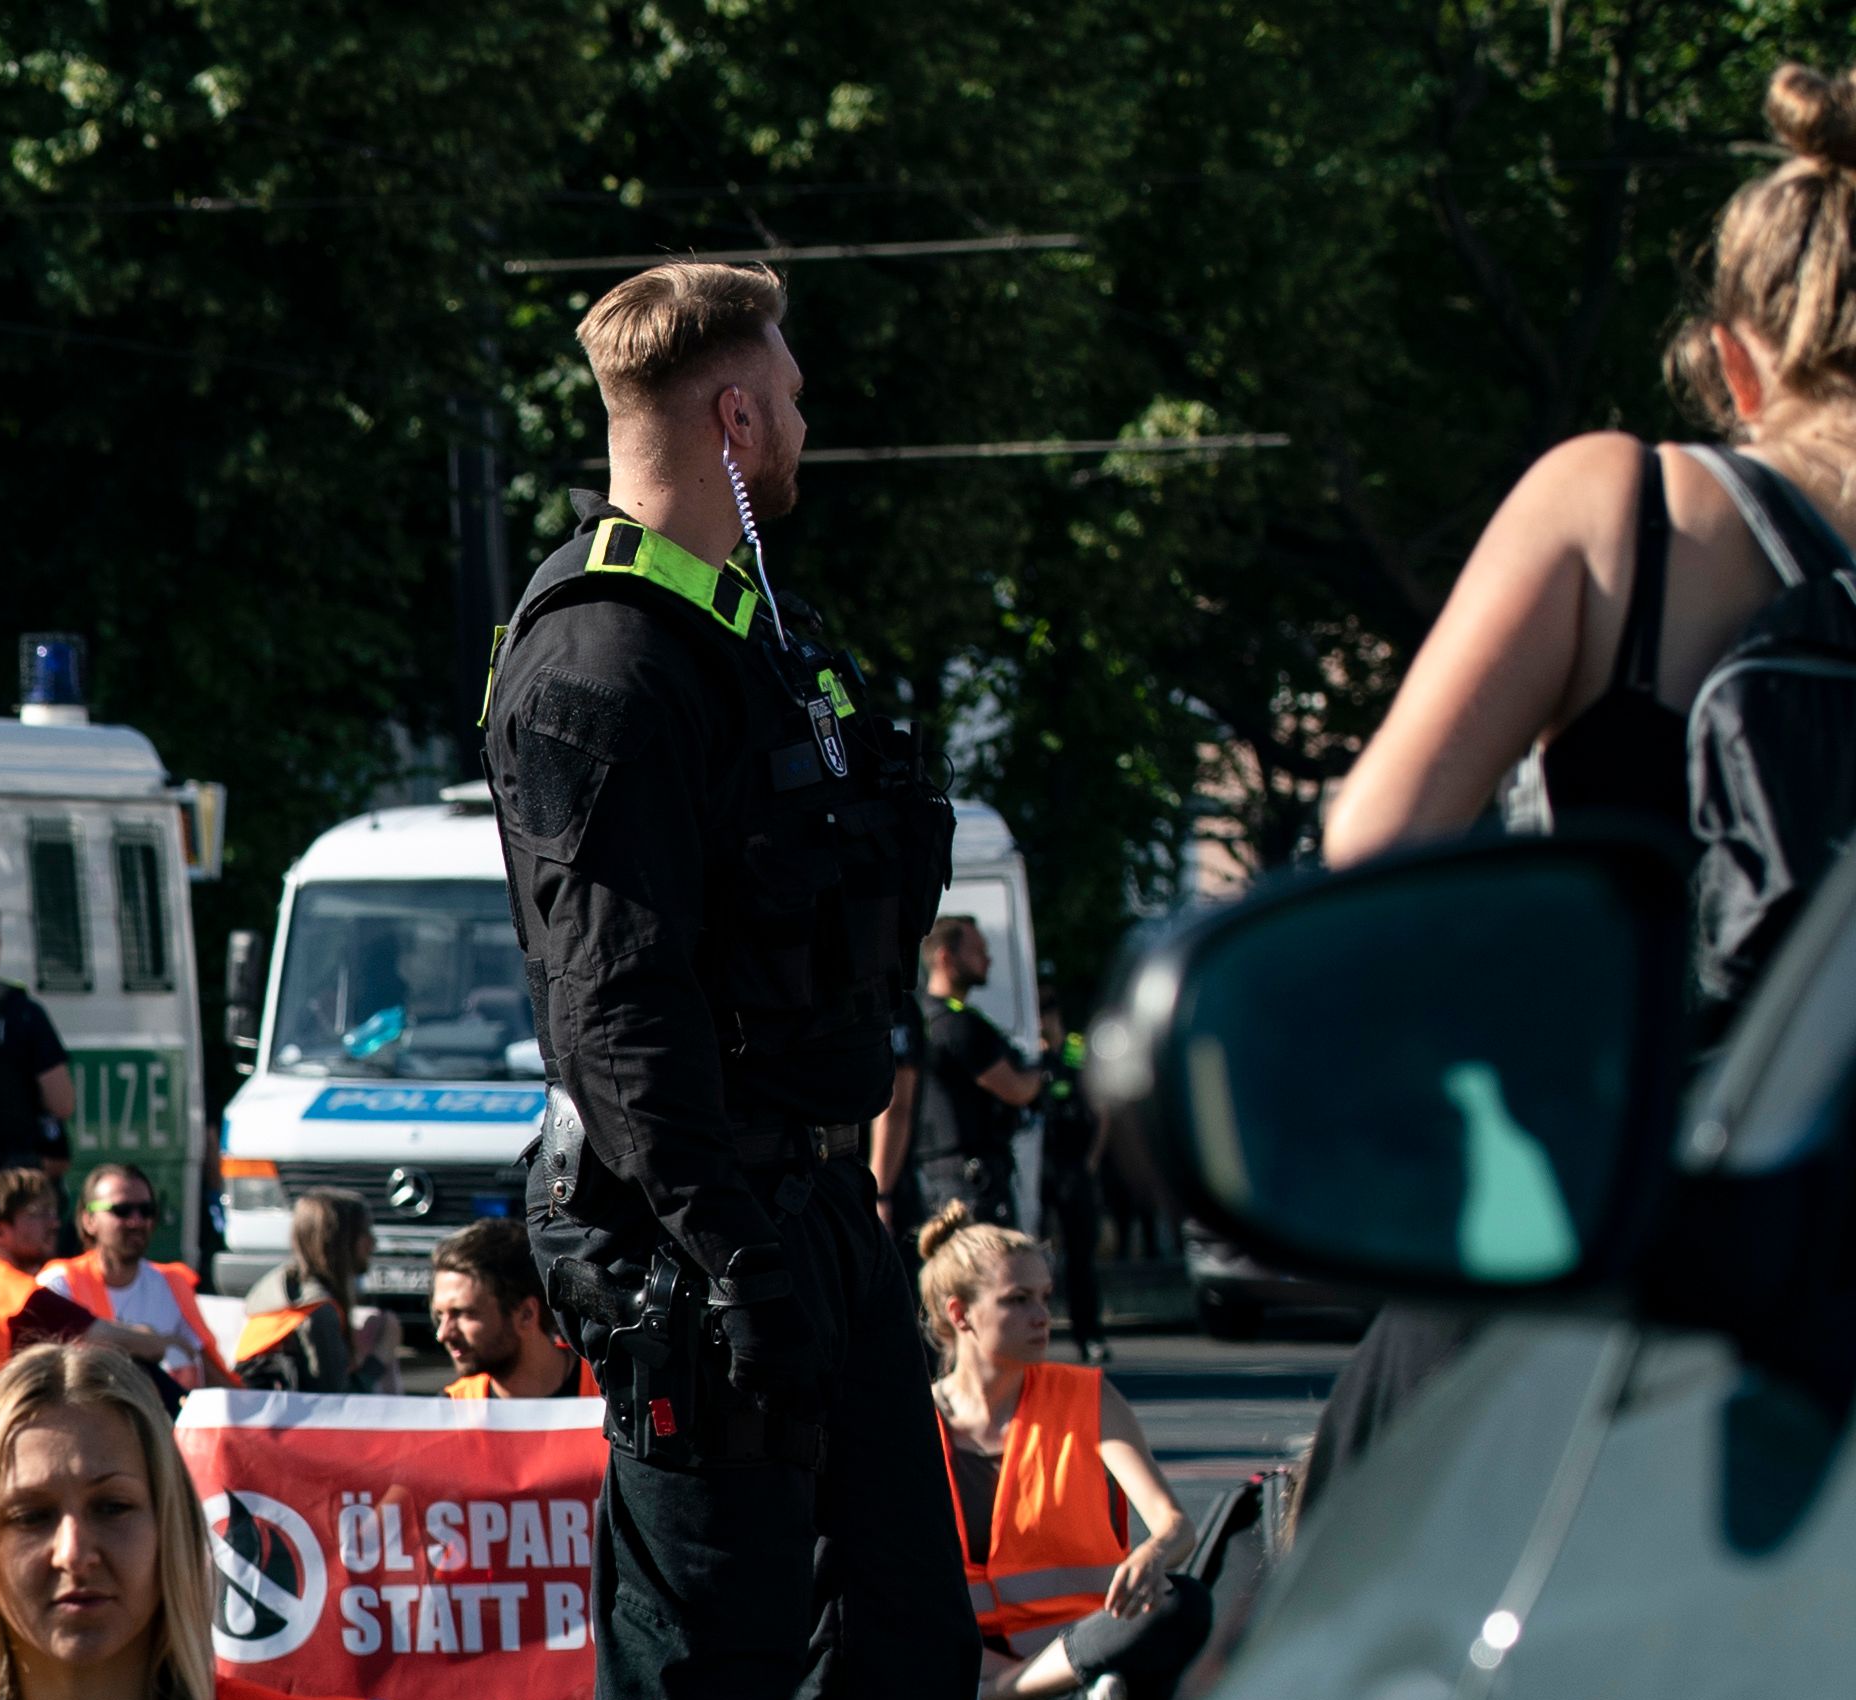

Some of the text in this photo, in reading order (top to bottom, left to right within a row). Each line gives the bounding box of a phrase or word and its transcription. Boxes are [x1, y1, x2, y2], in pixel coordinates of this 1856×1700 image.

[326, 1088, 539, 1114] POLIZEI
[338, 1491, 599, 1574] ÖL SPAR
[339, 1580, 596, 1656] STATT B
